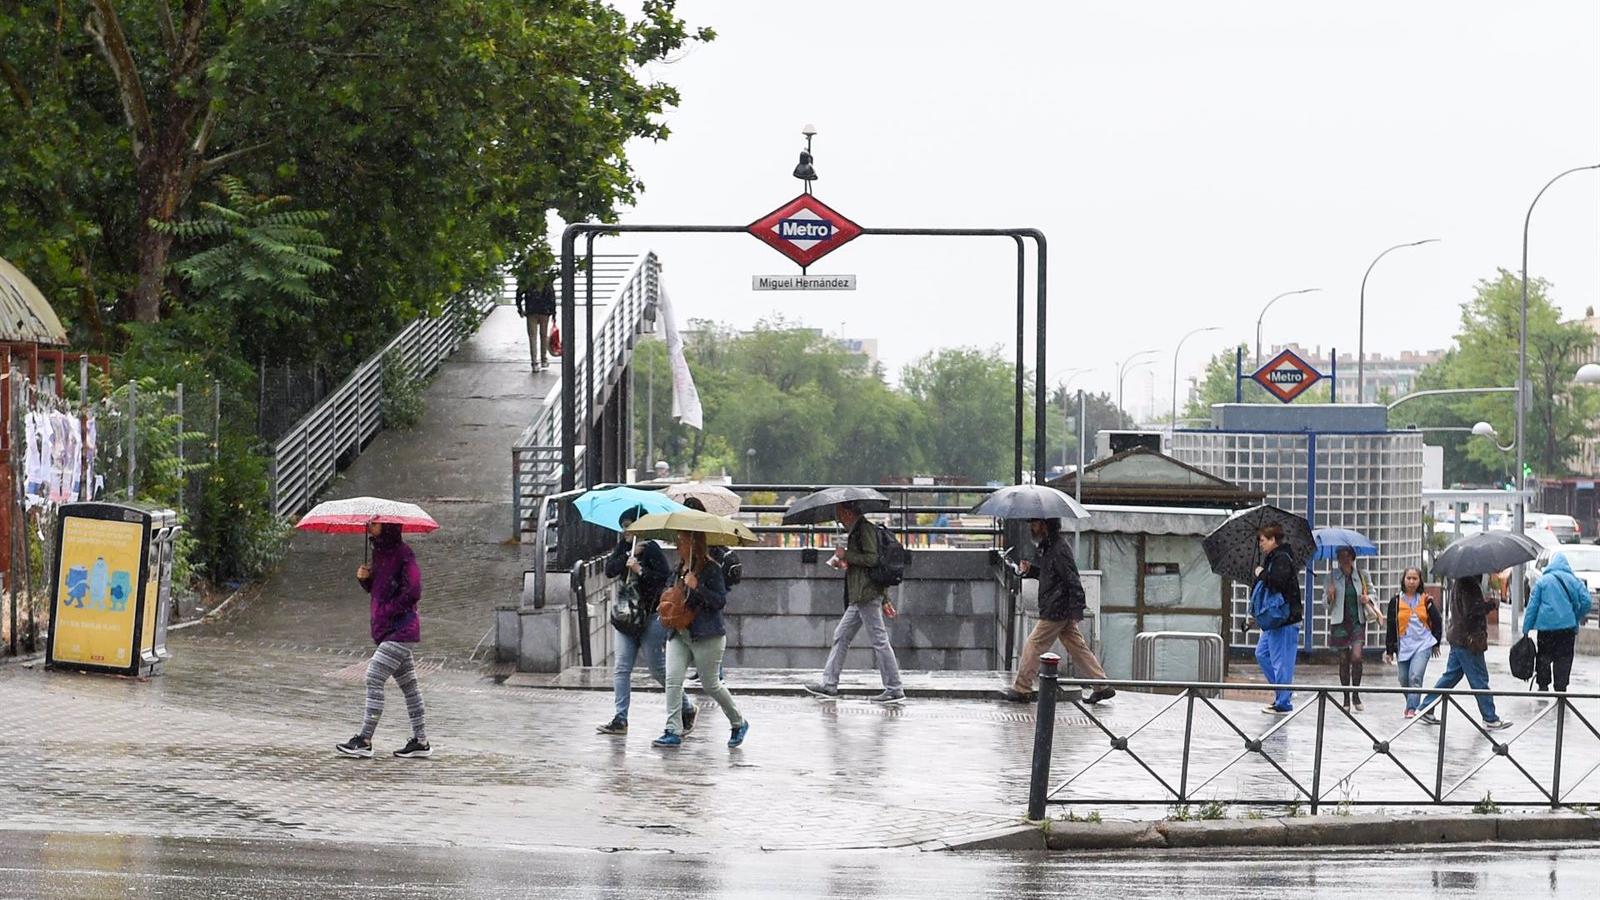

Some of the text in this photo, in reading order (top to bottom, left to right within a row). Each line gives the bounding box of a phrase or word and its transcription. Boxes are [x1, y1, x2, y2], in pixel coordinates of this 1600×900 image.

[782, 222, 829, 236] Metro
[759, 278, 849, 290] Miguel Hernández
[1271, 371, 1302, 382] Metro
